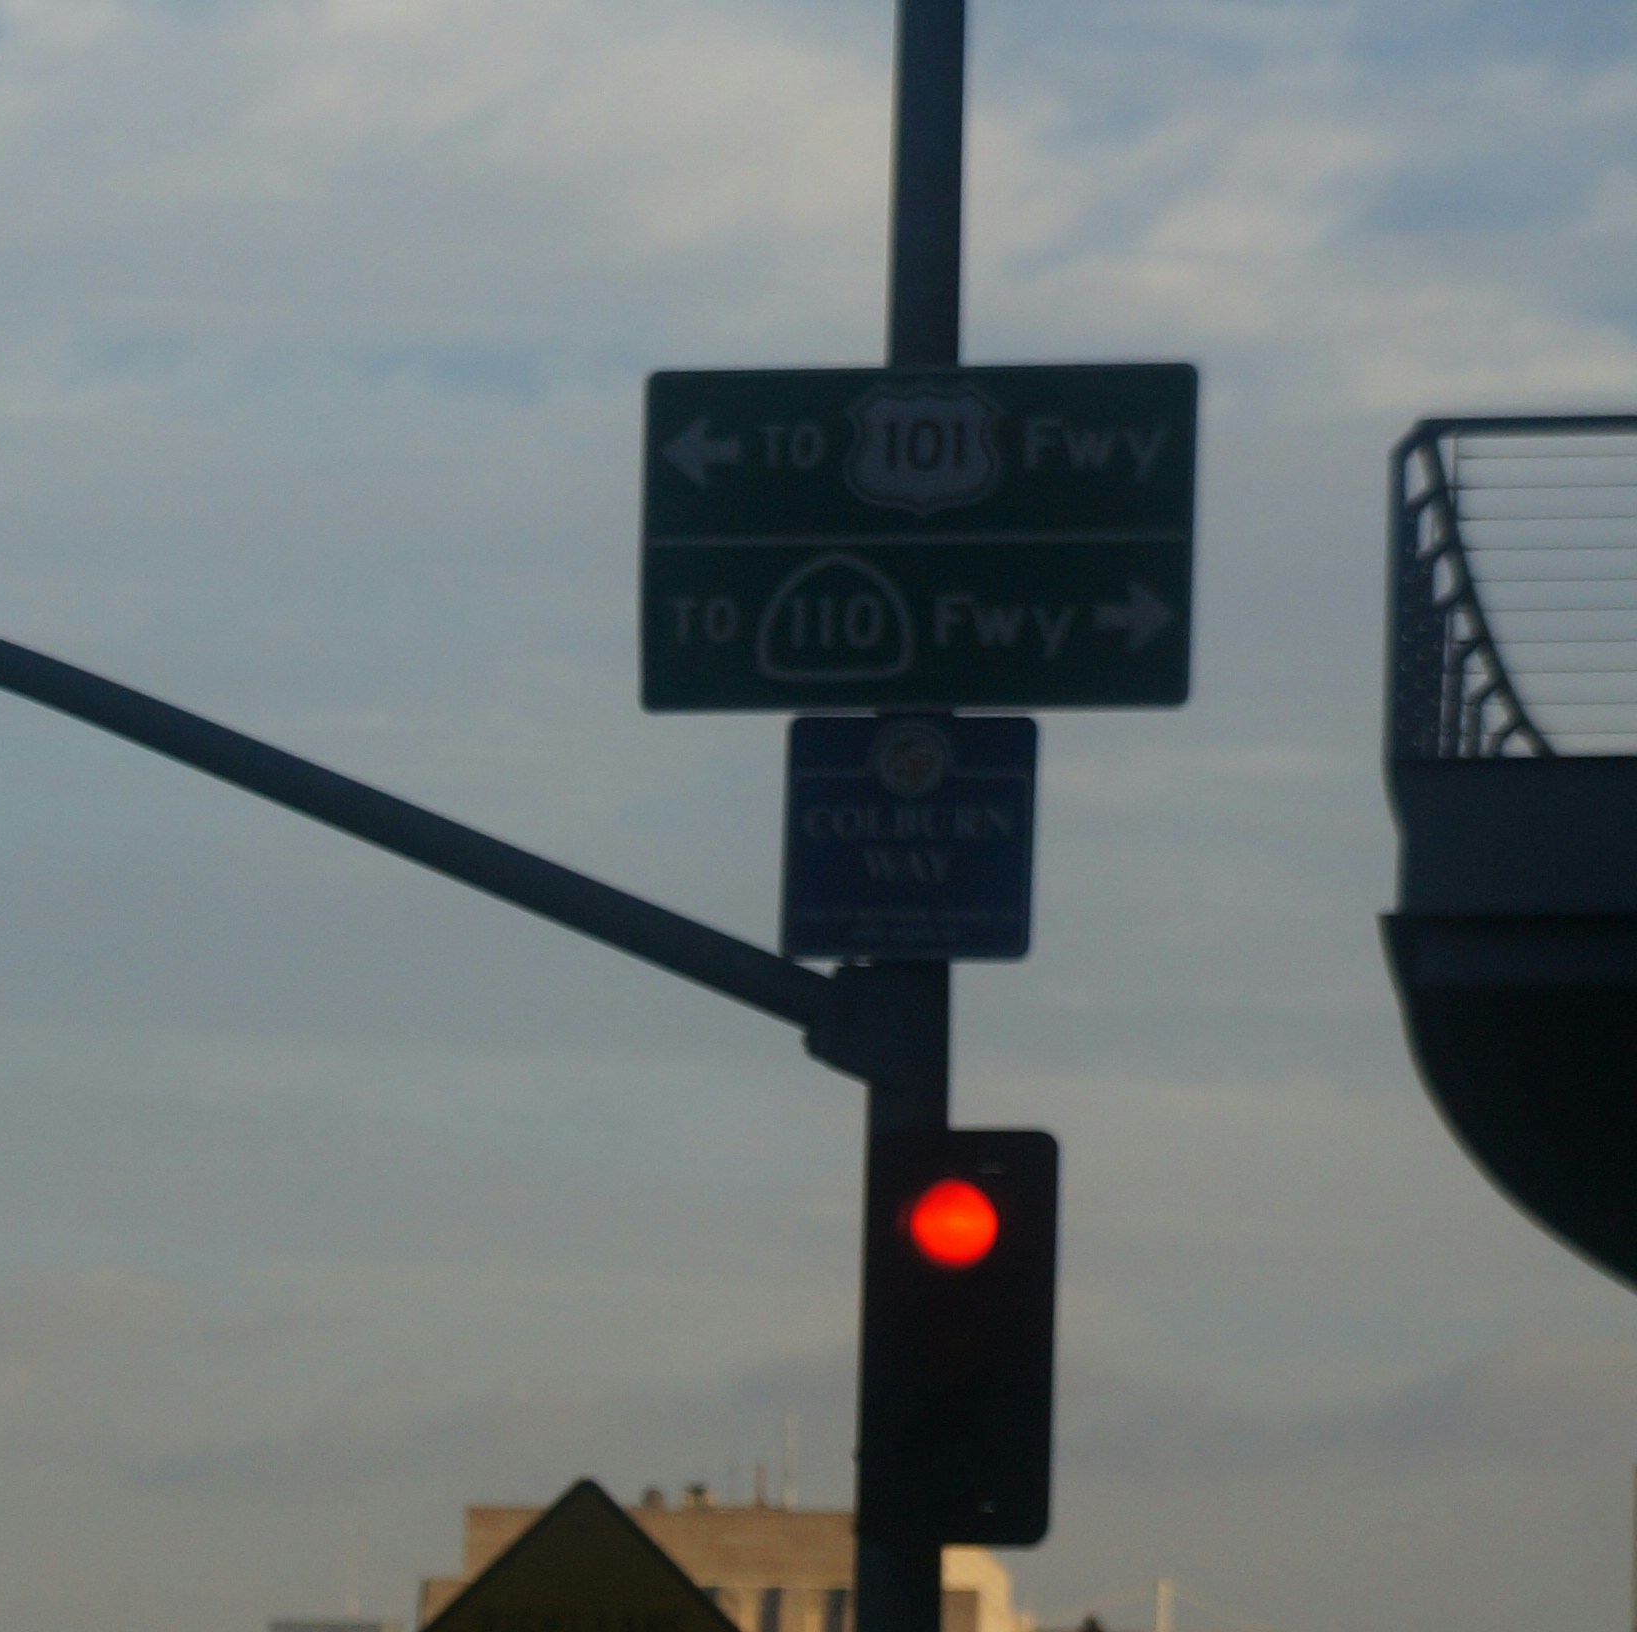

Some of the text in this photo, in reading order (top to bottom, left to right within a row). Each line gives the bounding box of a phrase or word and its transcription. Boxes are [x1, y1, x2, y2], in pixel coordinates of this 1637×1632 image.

[761, 417, 1165, 482] TO 101 Fwy
[672, 591, 1075, 659] TO 110 Fwy
[803, 804, 1013, 839] COLBURN
[863, 848, 949, 882] WAY
